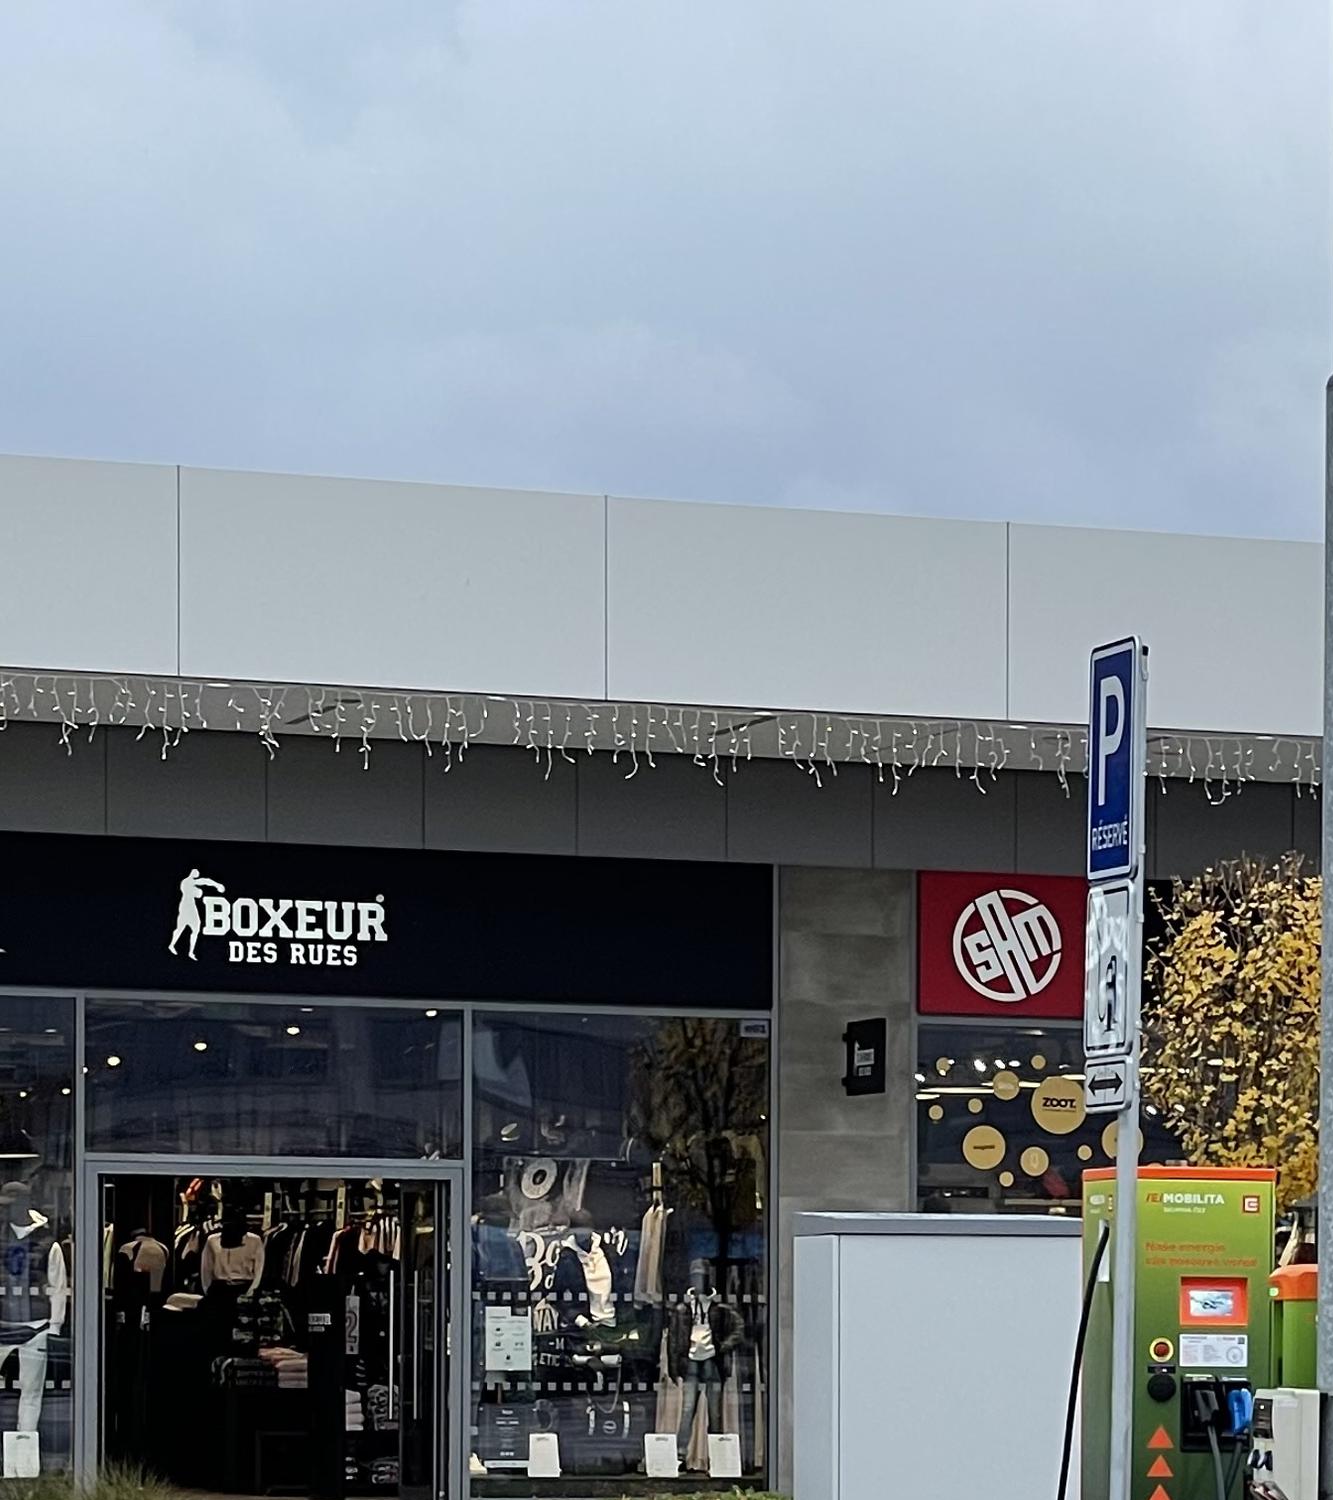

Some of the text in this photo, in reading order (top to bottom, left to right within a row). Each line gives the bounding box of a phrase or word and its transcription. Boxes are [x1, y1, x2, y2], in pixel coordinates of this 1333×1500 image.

[1097, 675, 1125, 806] P
[203, 896, 388, 941] BOXEUR
[229, 941, 358, 966] DES RUES
